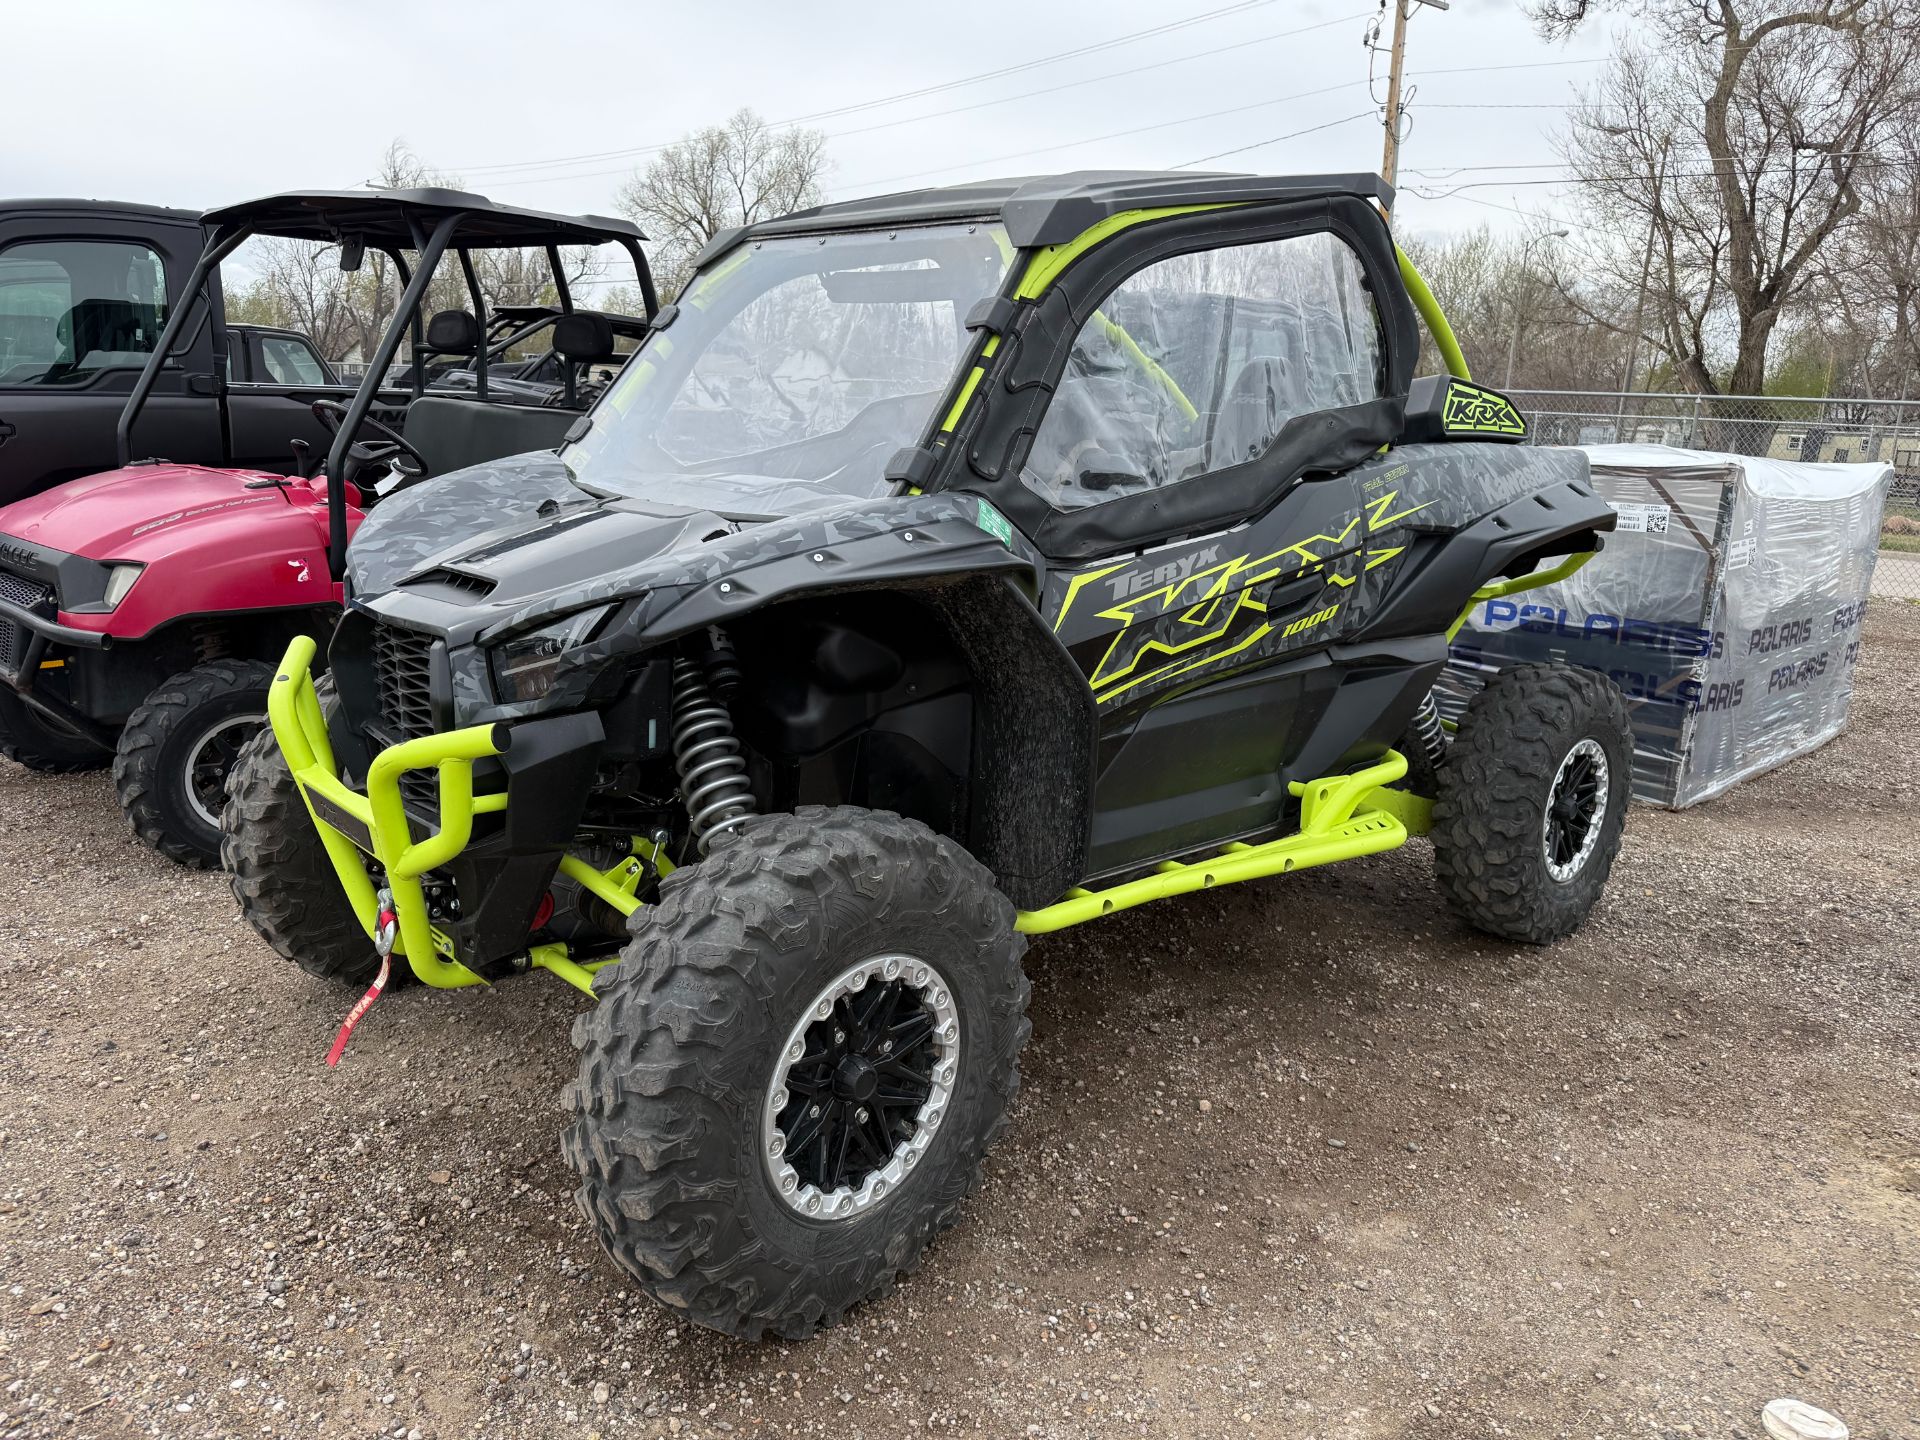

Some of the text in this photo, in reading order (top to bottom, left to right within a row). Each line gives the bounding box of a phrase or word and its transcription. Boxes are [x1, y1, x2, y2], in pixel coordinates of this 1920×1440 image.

[1451, 398, 1508, 425] KRX
[1362, 464, 1409, 492] TRAIL EDITION
[1479, 461, 1558, 504] Kawasaki
[1105, 544, 1223, 601] TERYX
[1282, 603, 1340, 639] 1000
[1484, 600, 1711, 657] POLARIS
[1749, 617, 1813, 656] POLARIS
[1768, 651, 1829, 694] POLARIS
[344, 994, 373, 1030] WARN
